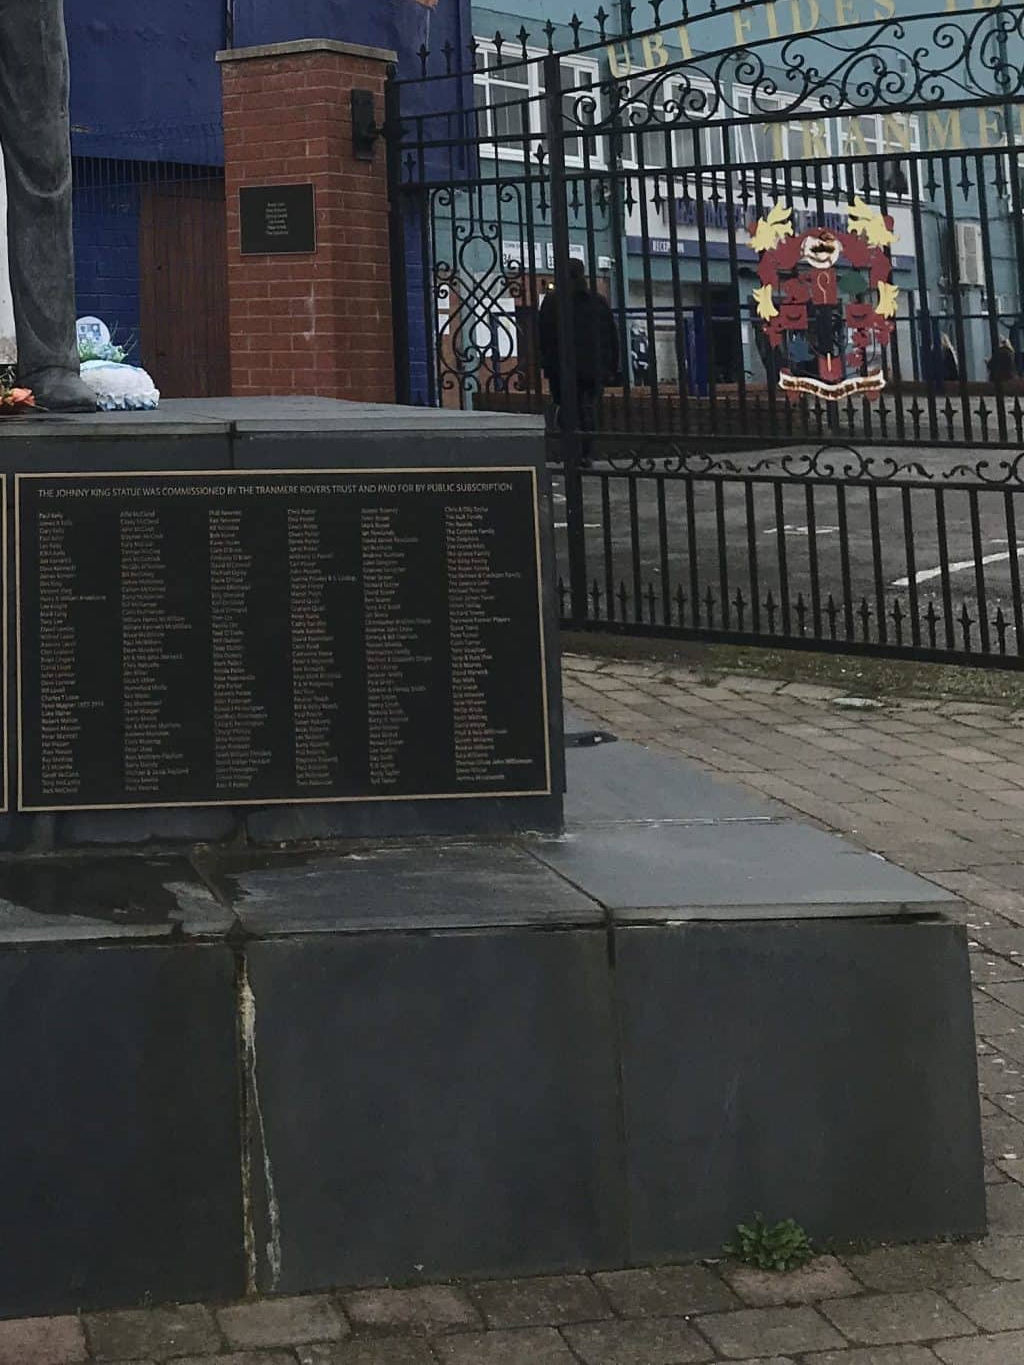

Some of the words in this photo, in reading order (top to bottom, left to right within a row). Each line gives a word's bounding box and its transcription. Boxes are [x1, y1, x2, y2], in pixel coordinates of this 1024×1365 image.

[607, 25, 693, 79] UBI
[763, 104, 1024, 161] TRANME
[38, 489, 55, 498] THE
[55, 489, 89, 498] JOHNNY
[90, 488, 111, 497] KING
[112, 488, 142, 497] STATUE
[143, 488, 162, 497] WAS
[162, 487, 226, 496] COMMISSIONED
[227, 486, 238, 495] BY
[238, 486, 256, 495] THE
[256, 485, 299, 495] TRANMERE
[299, 485, 332, 494] ROVERS
[333, 484, 357, 494] TRUST
[358, 484, 377, 493] AND
[377, 484, 397, 493] PAID
[397, 484, 415, 493] FOR
[415, 484, 426, 493] BY
[427, 483, 455, 492] PUBLIC
[456, 482, 513, 492] SUBSCRIPTION
